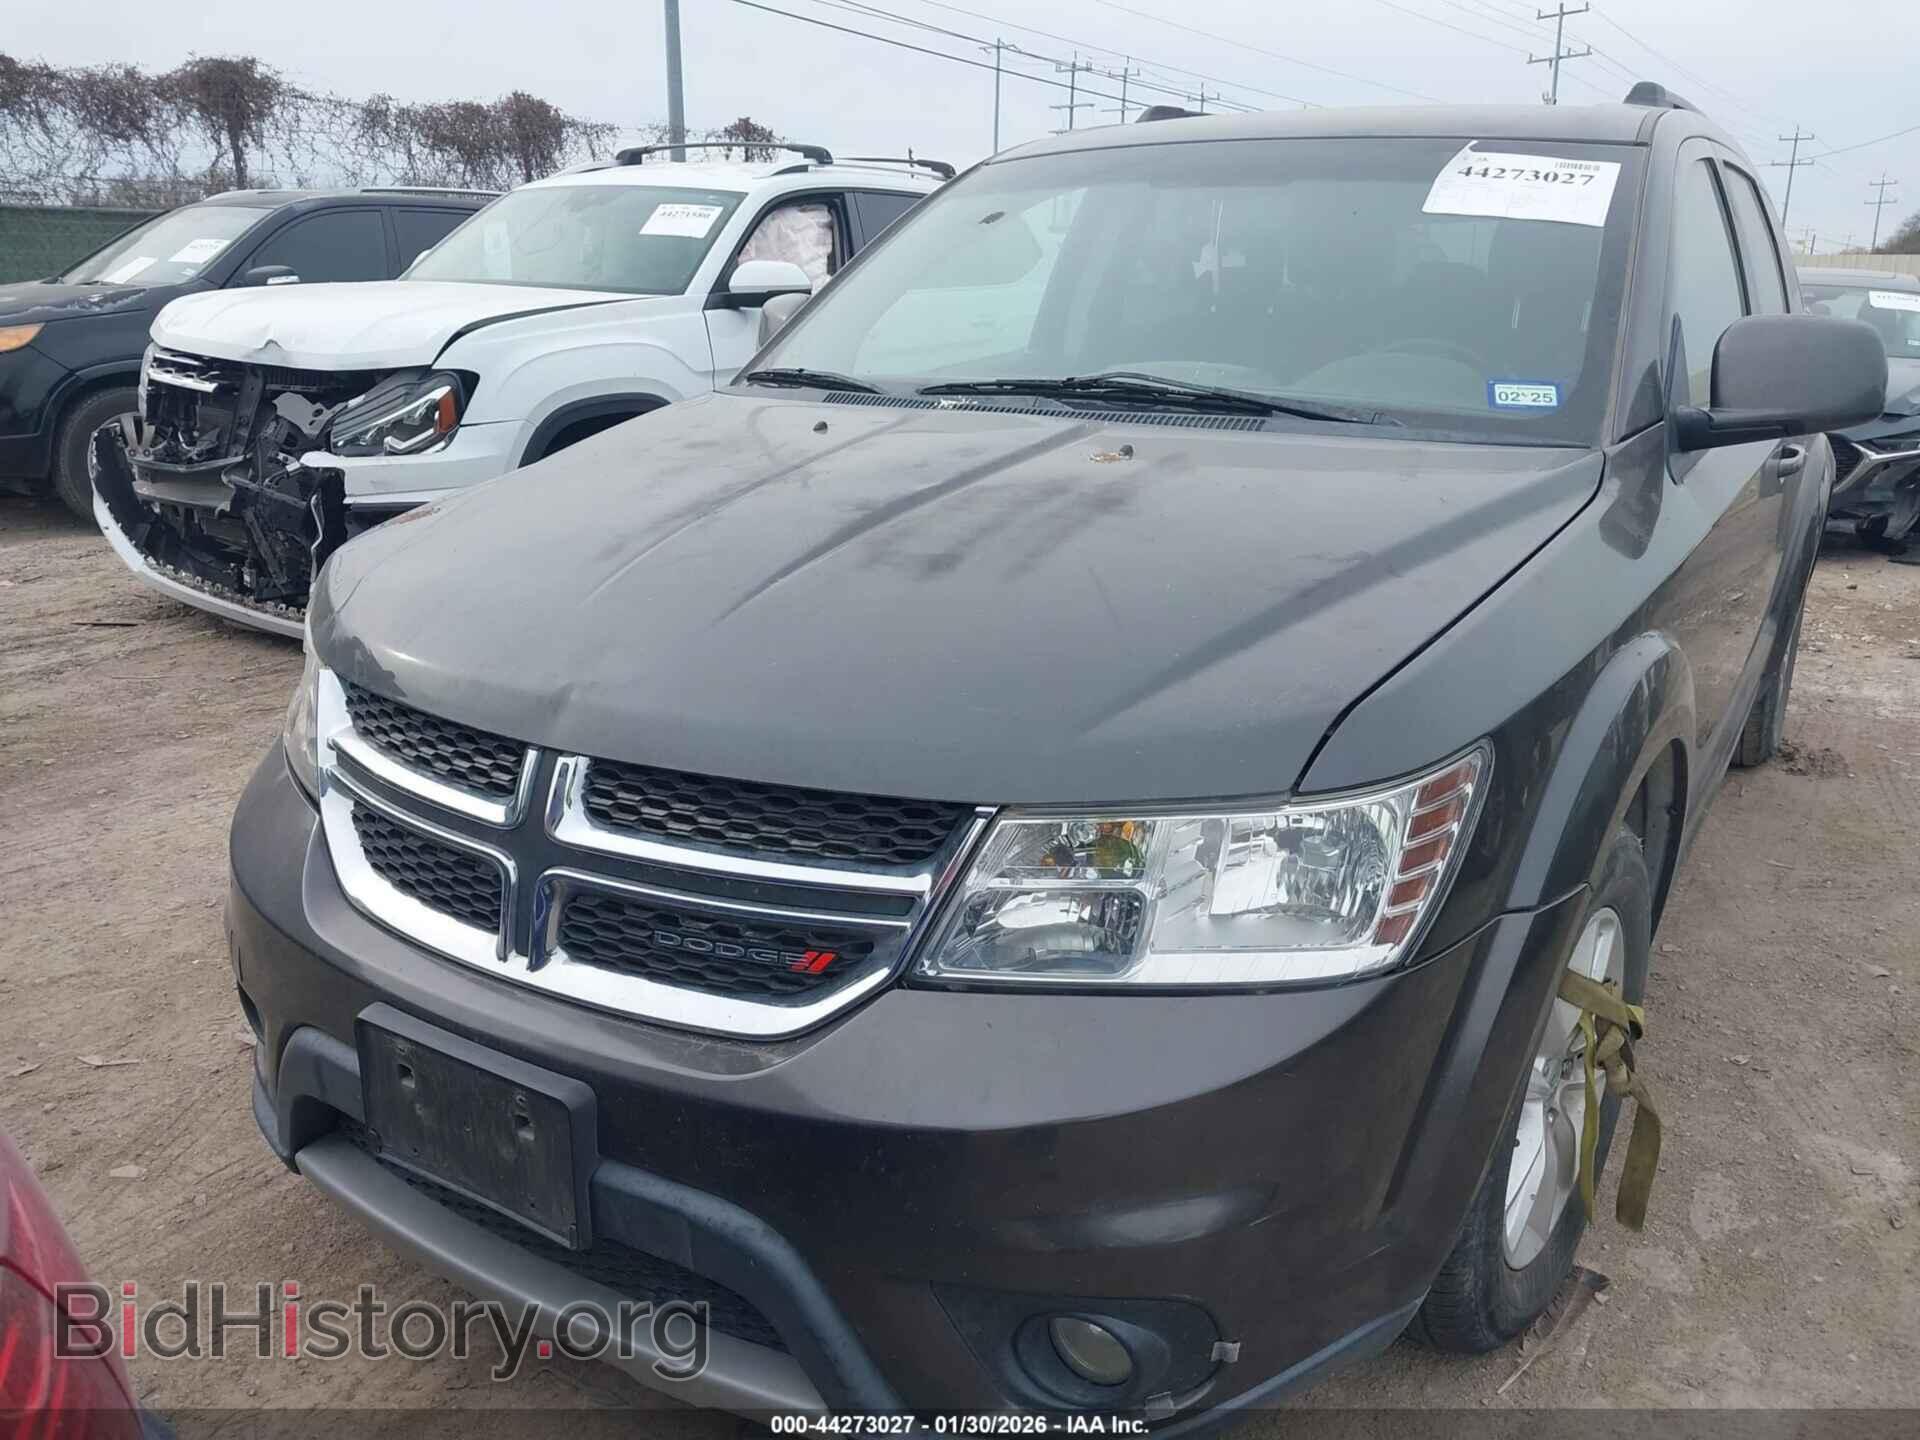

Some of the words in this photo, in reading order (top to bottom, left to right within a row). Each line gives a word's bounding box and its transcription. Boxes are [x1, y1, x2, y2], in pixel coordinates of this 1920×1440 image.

[1457, 165, 1596, 186] 44273027
[1498, 391, 1521, 402] 02
[1530, 392, 1553, 404] 25
[653, 930, 809, 967] DODGE
